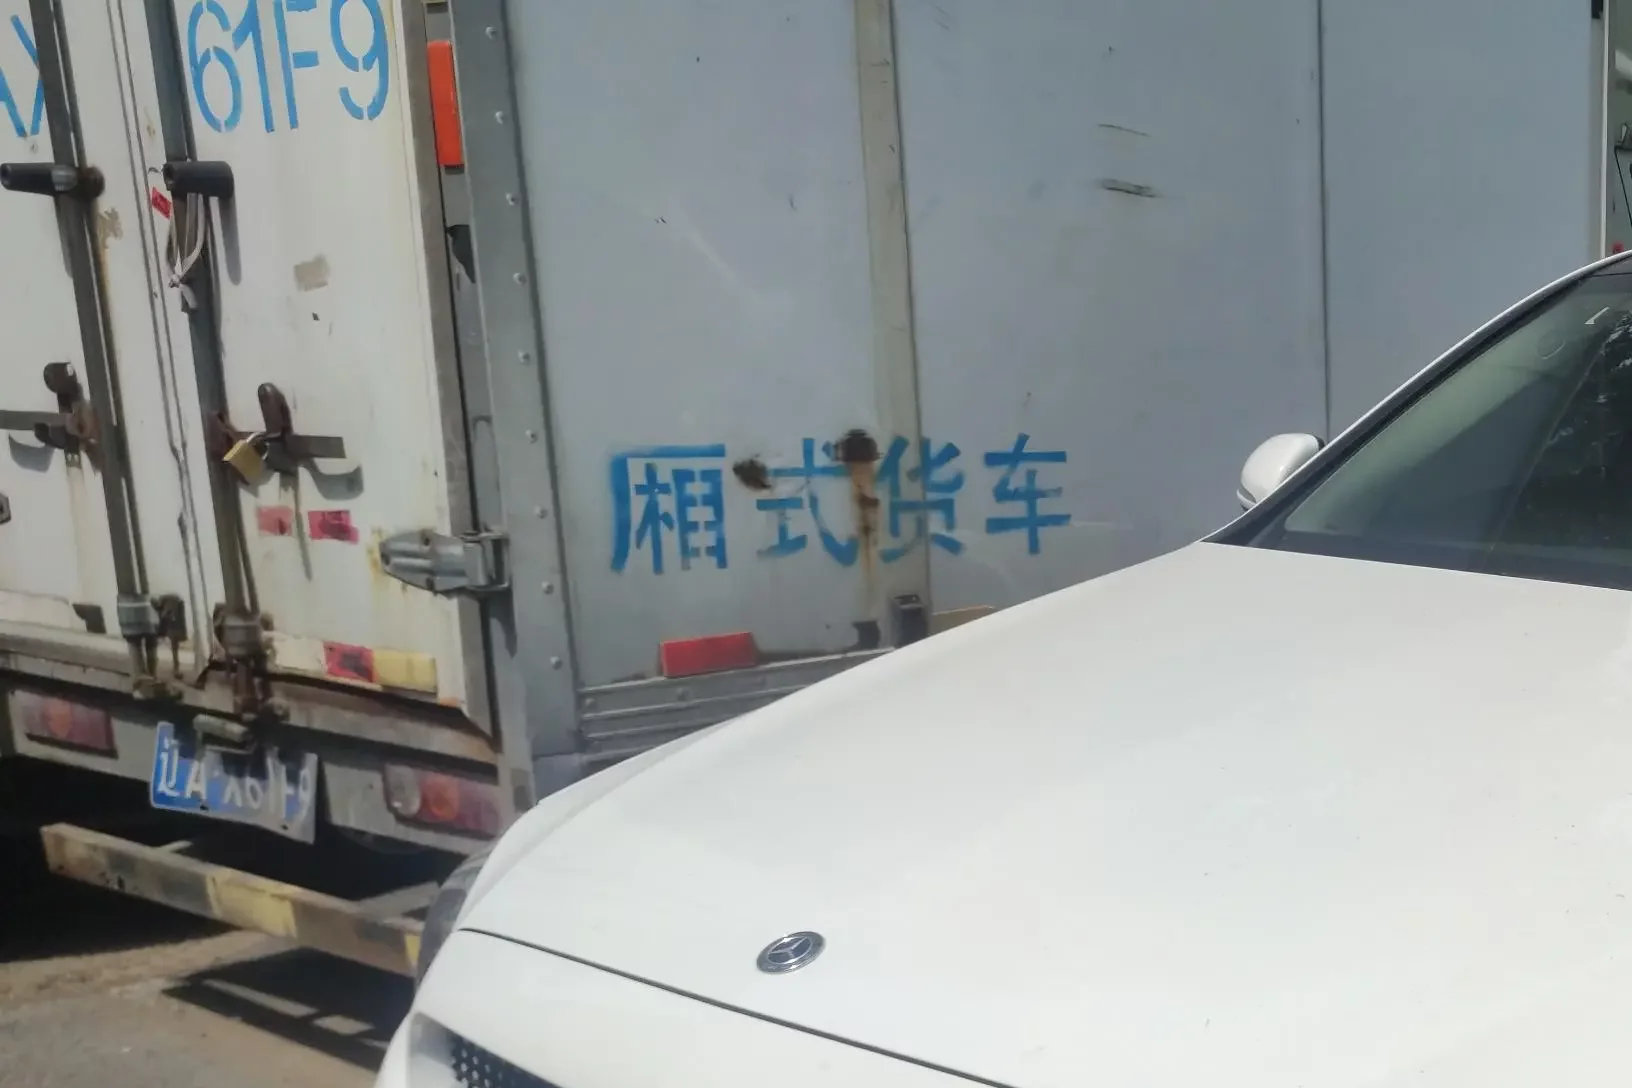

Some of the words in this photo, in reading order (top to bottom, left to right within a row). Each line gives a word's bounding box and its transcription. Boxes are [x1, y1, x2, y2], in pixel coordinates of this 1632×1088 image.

[188, 0, 389, 133] 61F9
[610, 433, 1072, 575] 厢式货车
